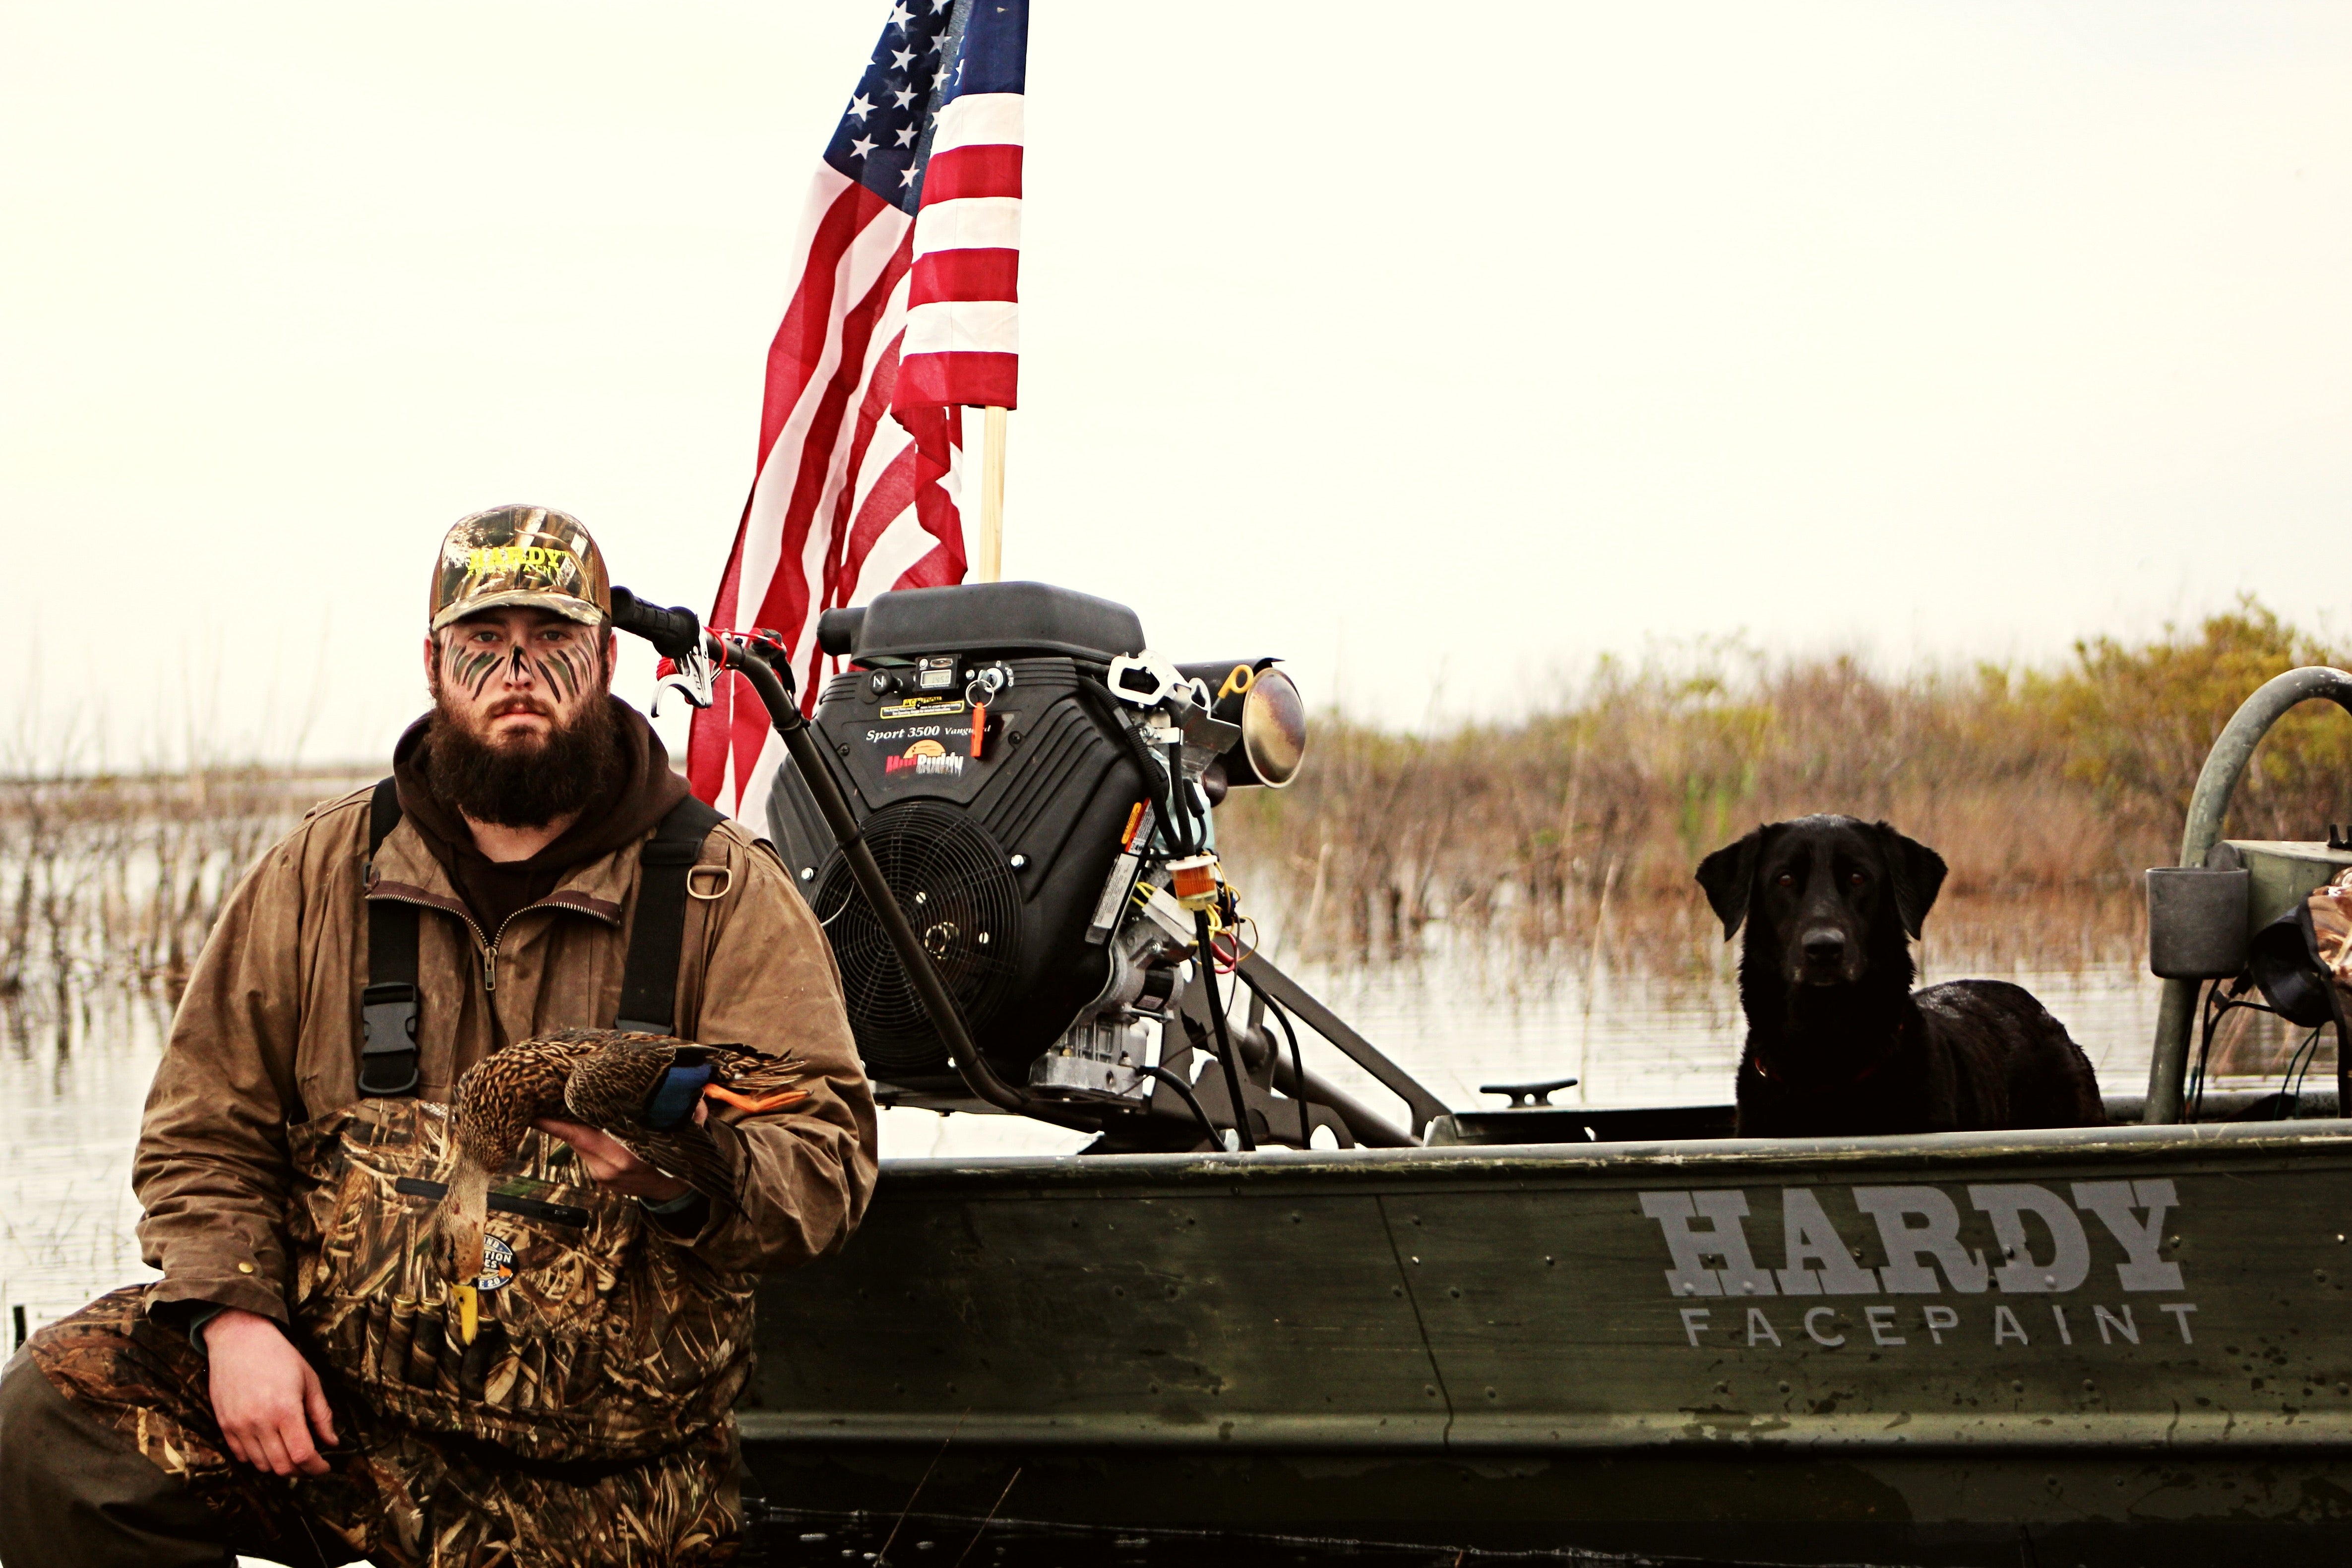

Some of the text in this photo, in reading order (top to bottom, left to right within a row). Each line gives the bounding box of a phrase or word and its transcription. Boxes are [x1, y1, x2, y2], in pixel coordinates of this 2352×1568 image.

[873, 675, 884, 687] N
[866, 725, 991, 742] Sport 3500 Vangud
[1638, 1178, 2184, 1297] HARDY
[484, 1250, 511, 1263] TION
[484, 1259, 497, 1268] ES
[488, 1277, 500, 1287] 2.0
[1679, 1302, 2198, 1348] FACEPAINT
